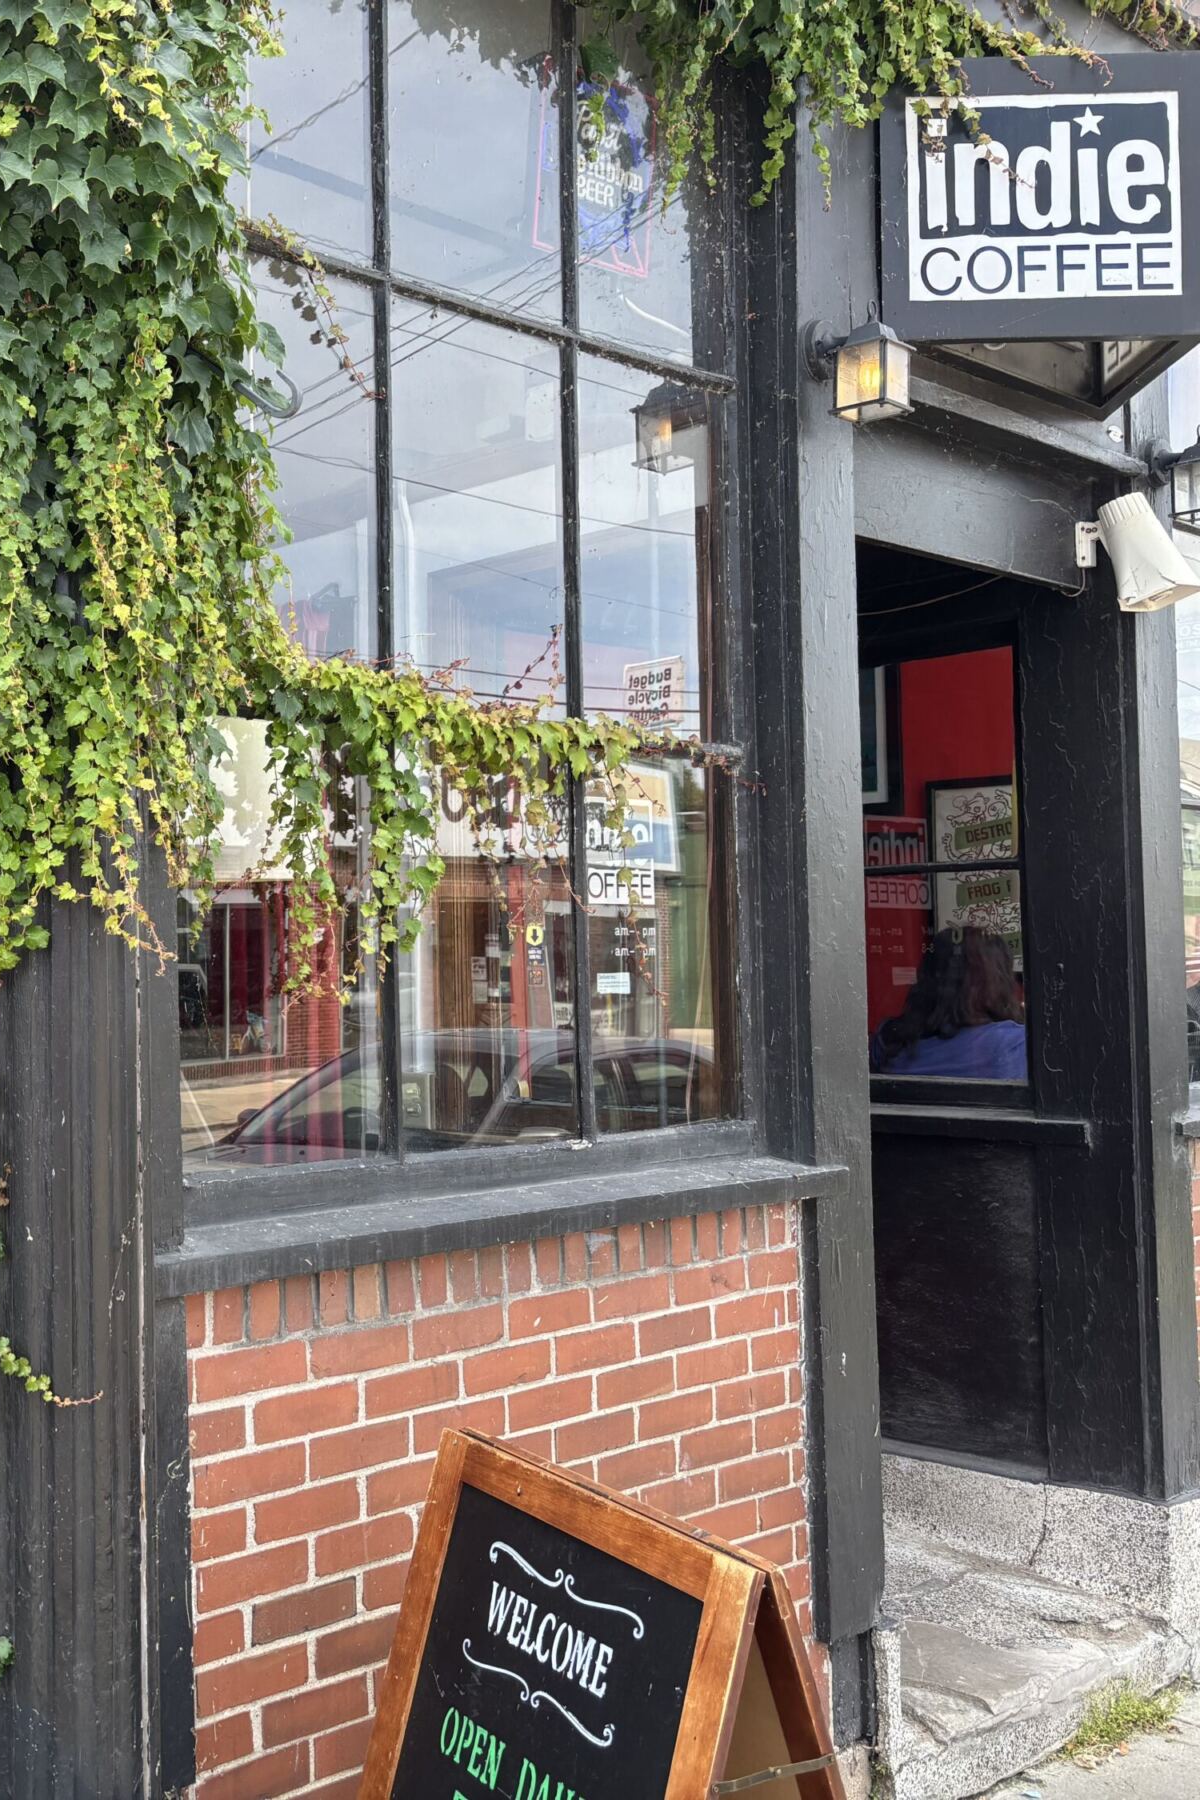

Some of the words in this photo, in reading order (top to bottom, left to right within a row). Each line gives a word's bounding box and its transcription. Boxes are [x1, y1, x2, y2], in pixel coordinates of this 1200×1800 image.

[925, 106, 1165, 233] indie
[920, 242, 1175, 296] COFFEE
[967, 881, 1001, 900] FROG
[488, 1580, 614, 1699] WELCOME
[440, 1707, 506, 1790] OPEN
